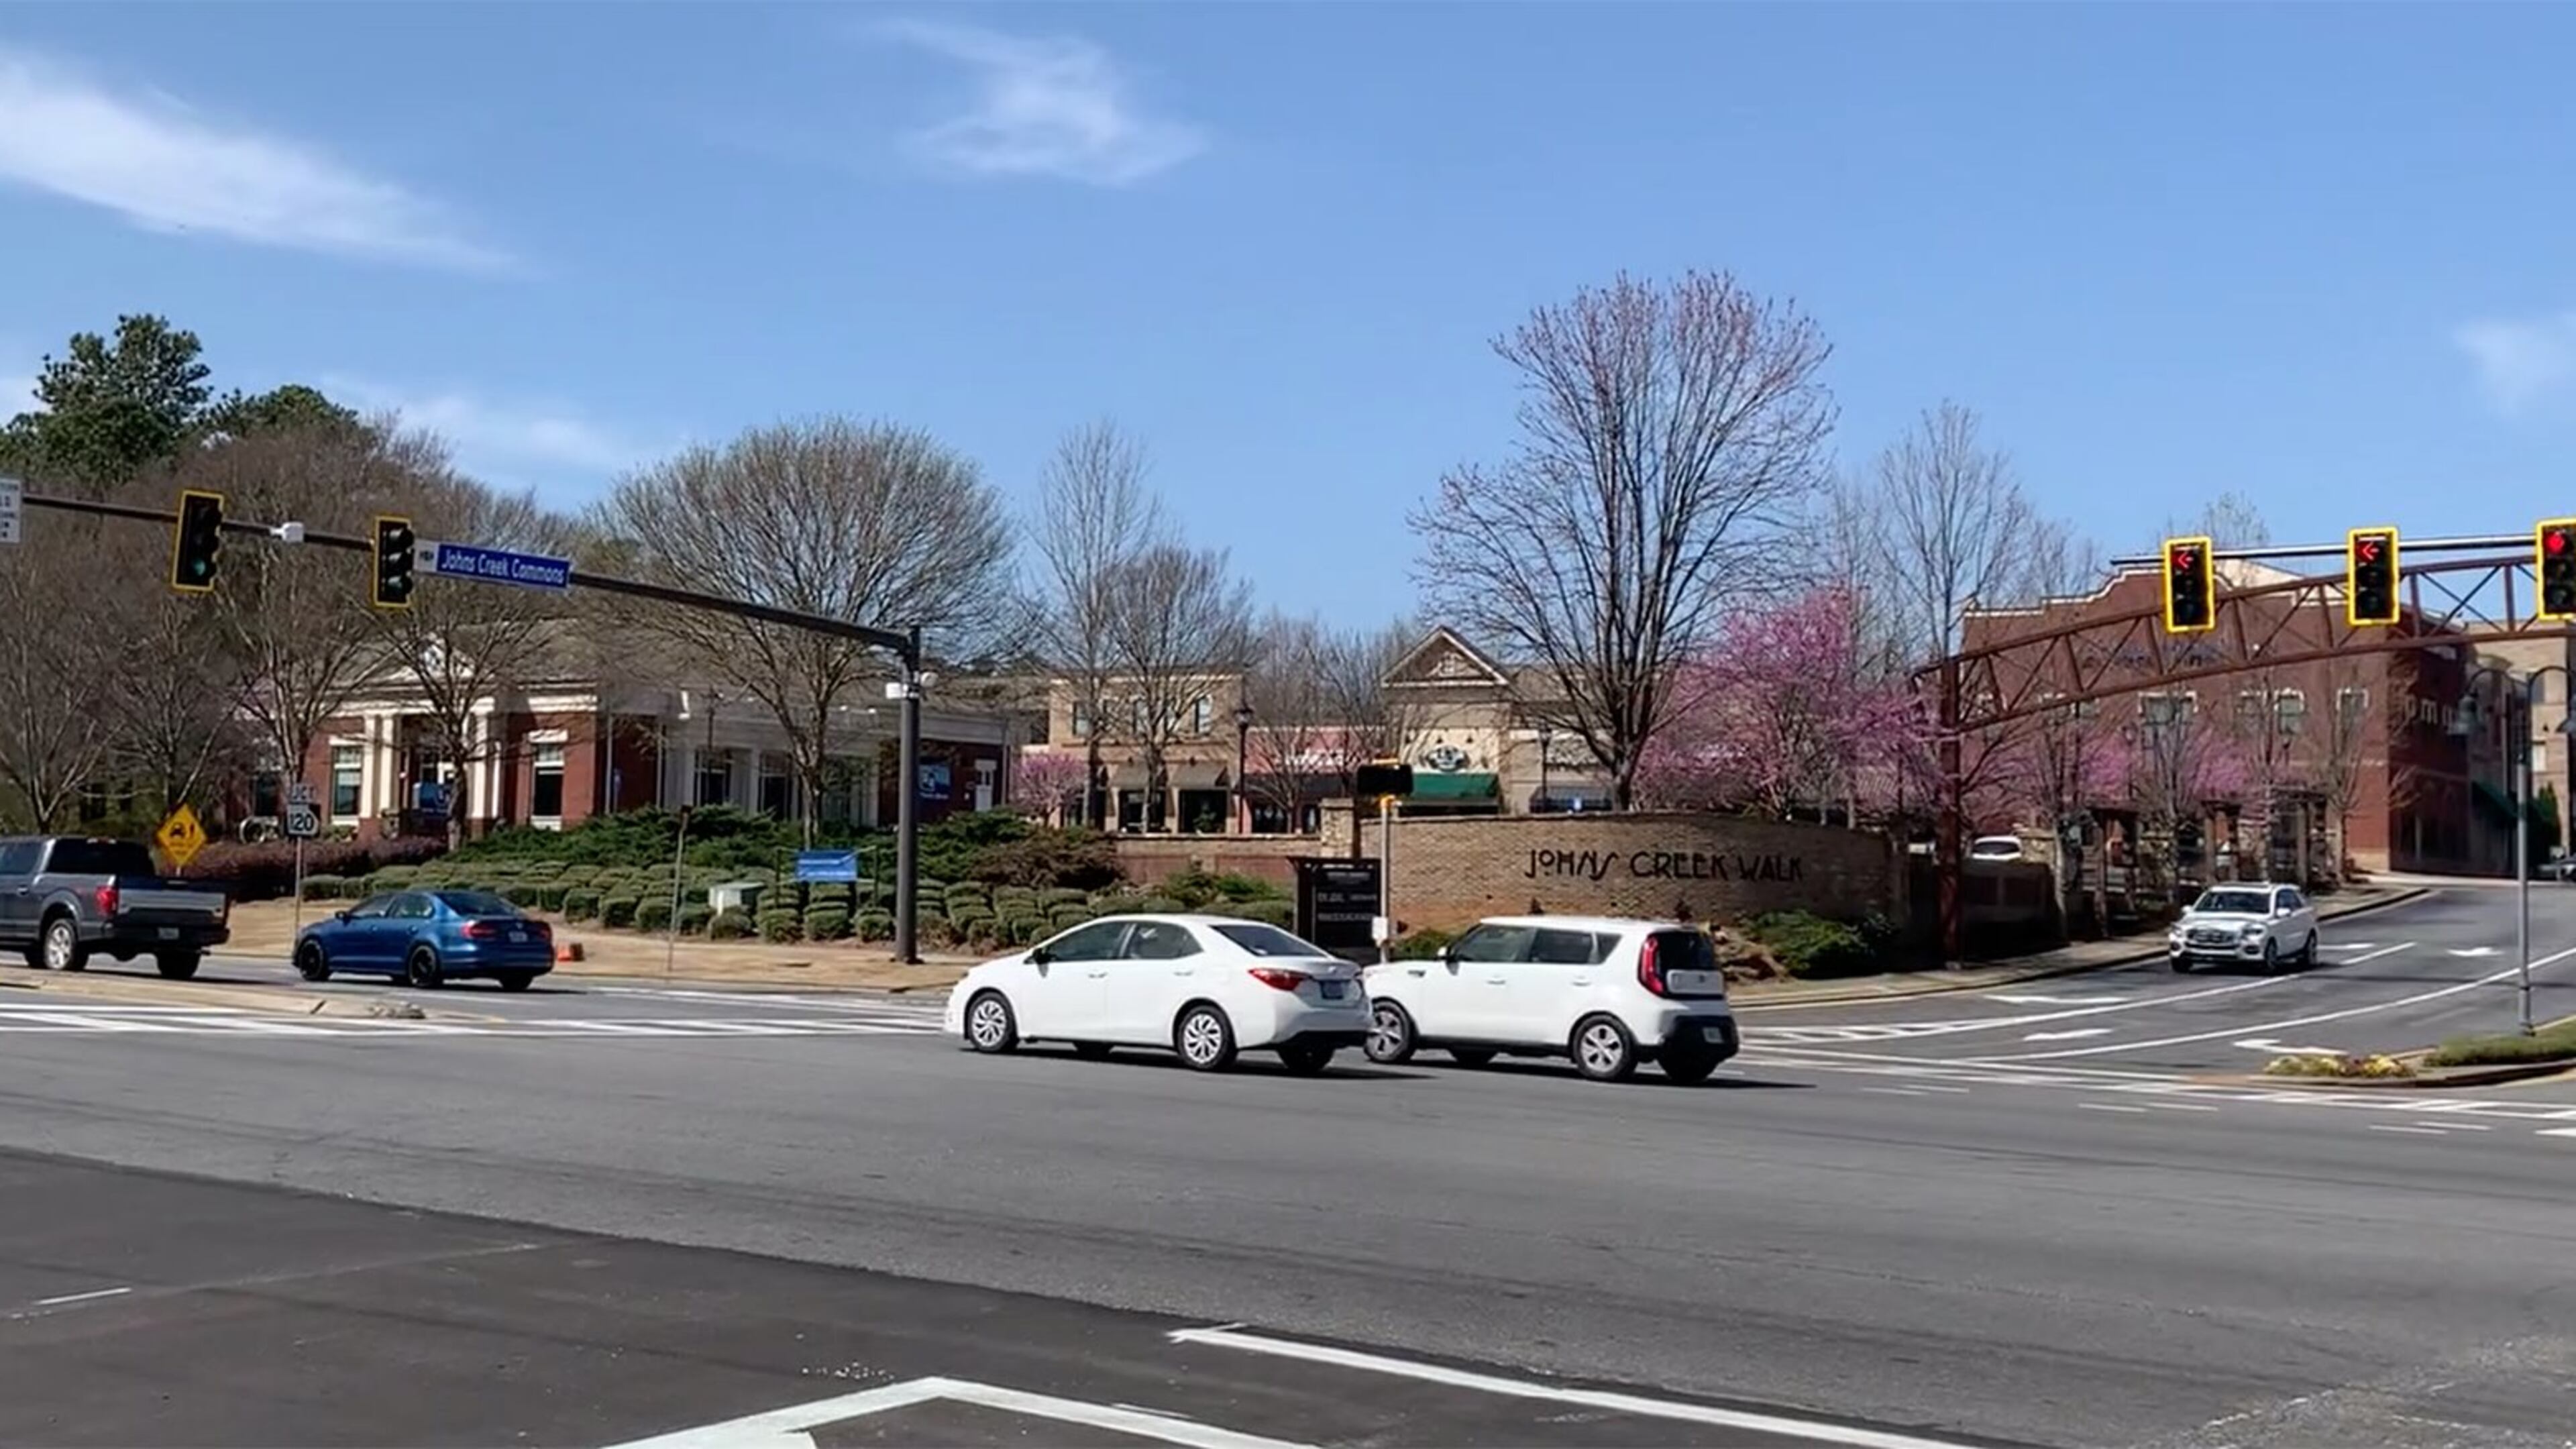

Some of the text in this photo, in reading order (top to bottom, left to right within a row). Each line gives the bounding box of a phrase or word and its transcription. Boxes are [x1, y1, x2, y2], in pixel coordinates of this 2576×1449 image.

[441, 549, 476, 572] Johns
[477, 553, 508, 577] Creek
[511, 557, 564, 584] Commons
[290, 812, 315, 832] 120
[1525, 849, 1805, 882] JOHNS CREEK WALK
